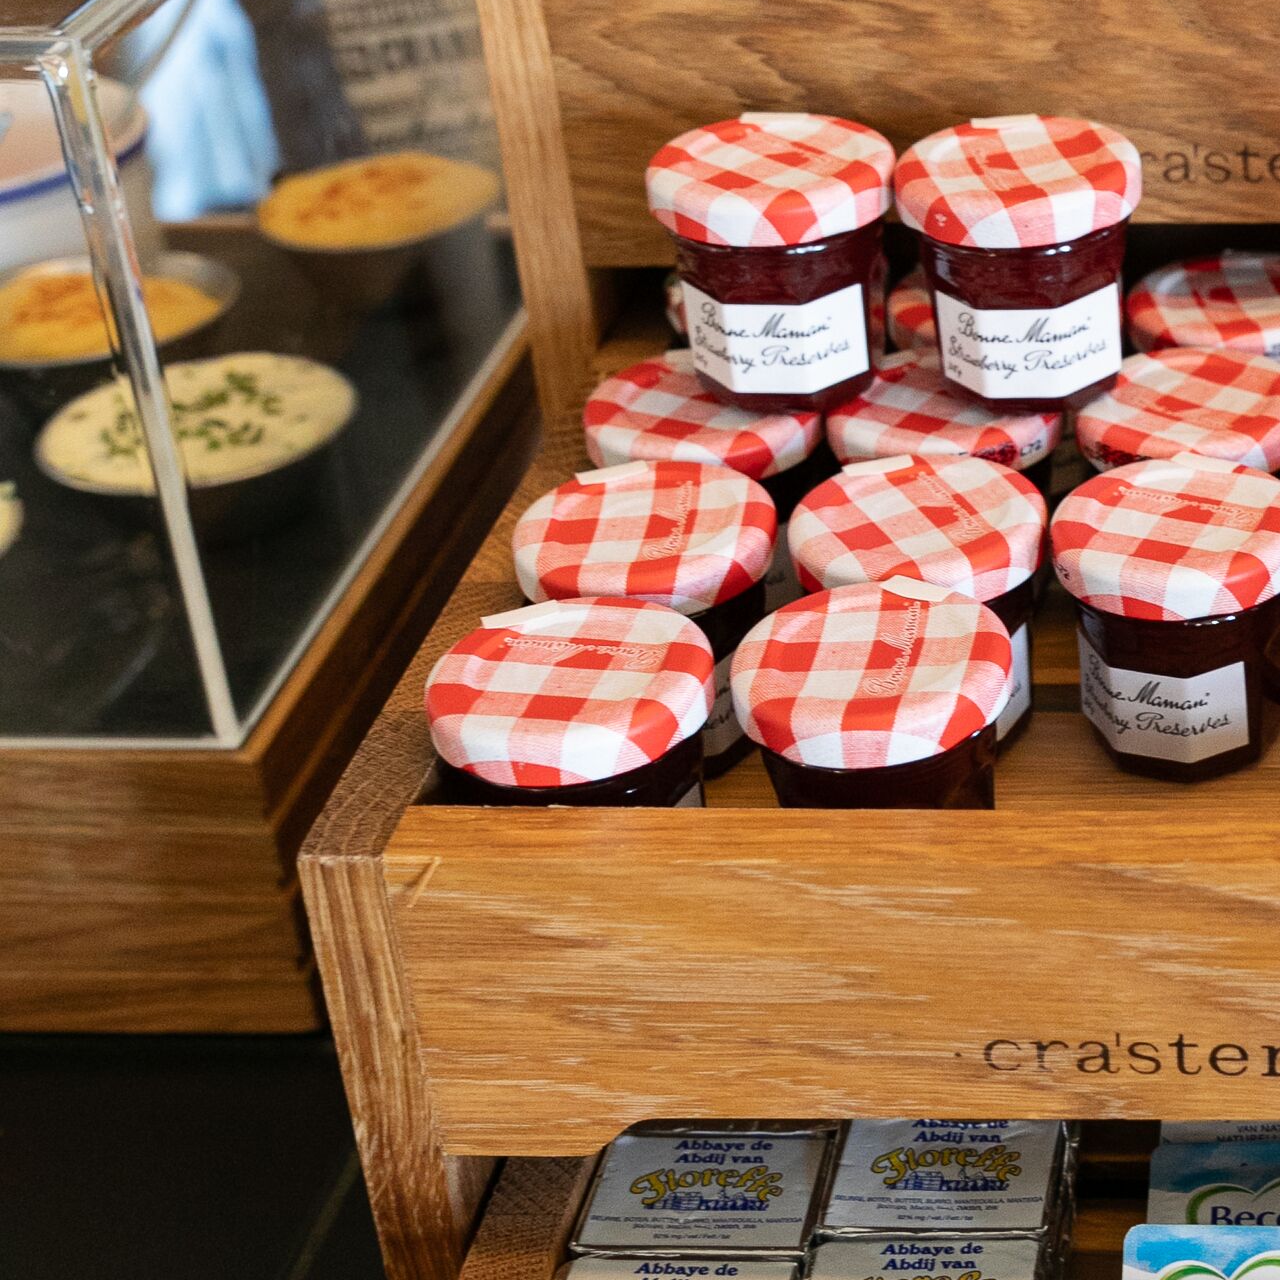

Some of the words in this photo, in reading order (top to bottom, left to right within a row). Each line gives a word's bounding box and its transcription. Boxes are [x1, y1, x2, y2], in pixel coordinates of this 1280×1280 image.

[958, 312, 1013, 344] Bonne
[1128, 680, 1211, 711] Maman
[1136, 712, 1232, 737] Preserves
[912, 1119, 980, 1130] Abbaye
[987, 1119, 1009, 1128] de
[913, 1131, 965, 1144] Abdij
[969, 1133, 1002, 1143] van
[674, 1140, 746, 1153] Abbaye
[750, 1140, 774, 1151] de
[674, 1154, 727, 1164] Abdij
[731, 1155, 765, 1163] van
[880, 1243, 955, 1256] Abbaye
[960, 1242, 985, 1255] de
[634, 1263, 709, 1277] Abbaye
[714, 1263, 739, 1276] de
[882, 1258, 936, 1271] Abdij
[941, 1260, 977, 1269] van
